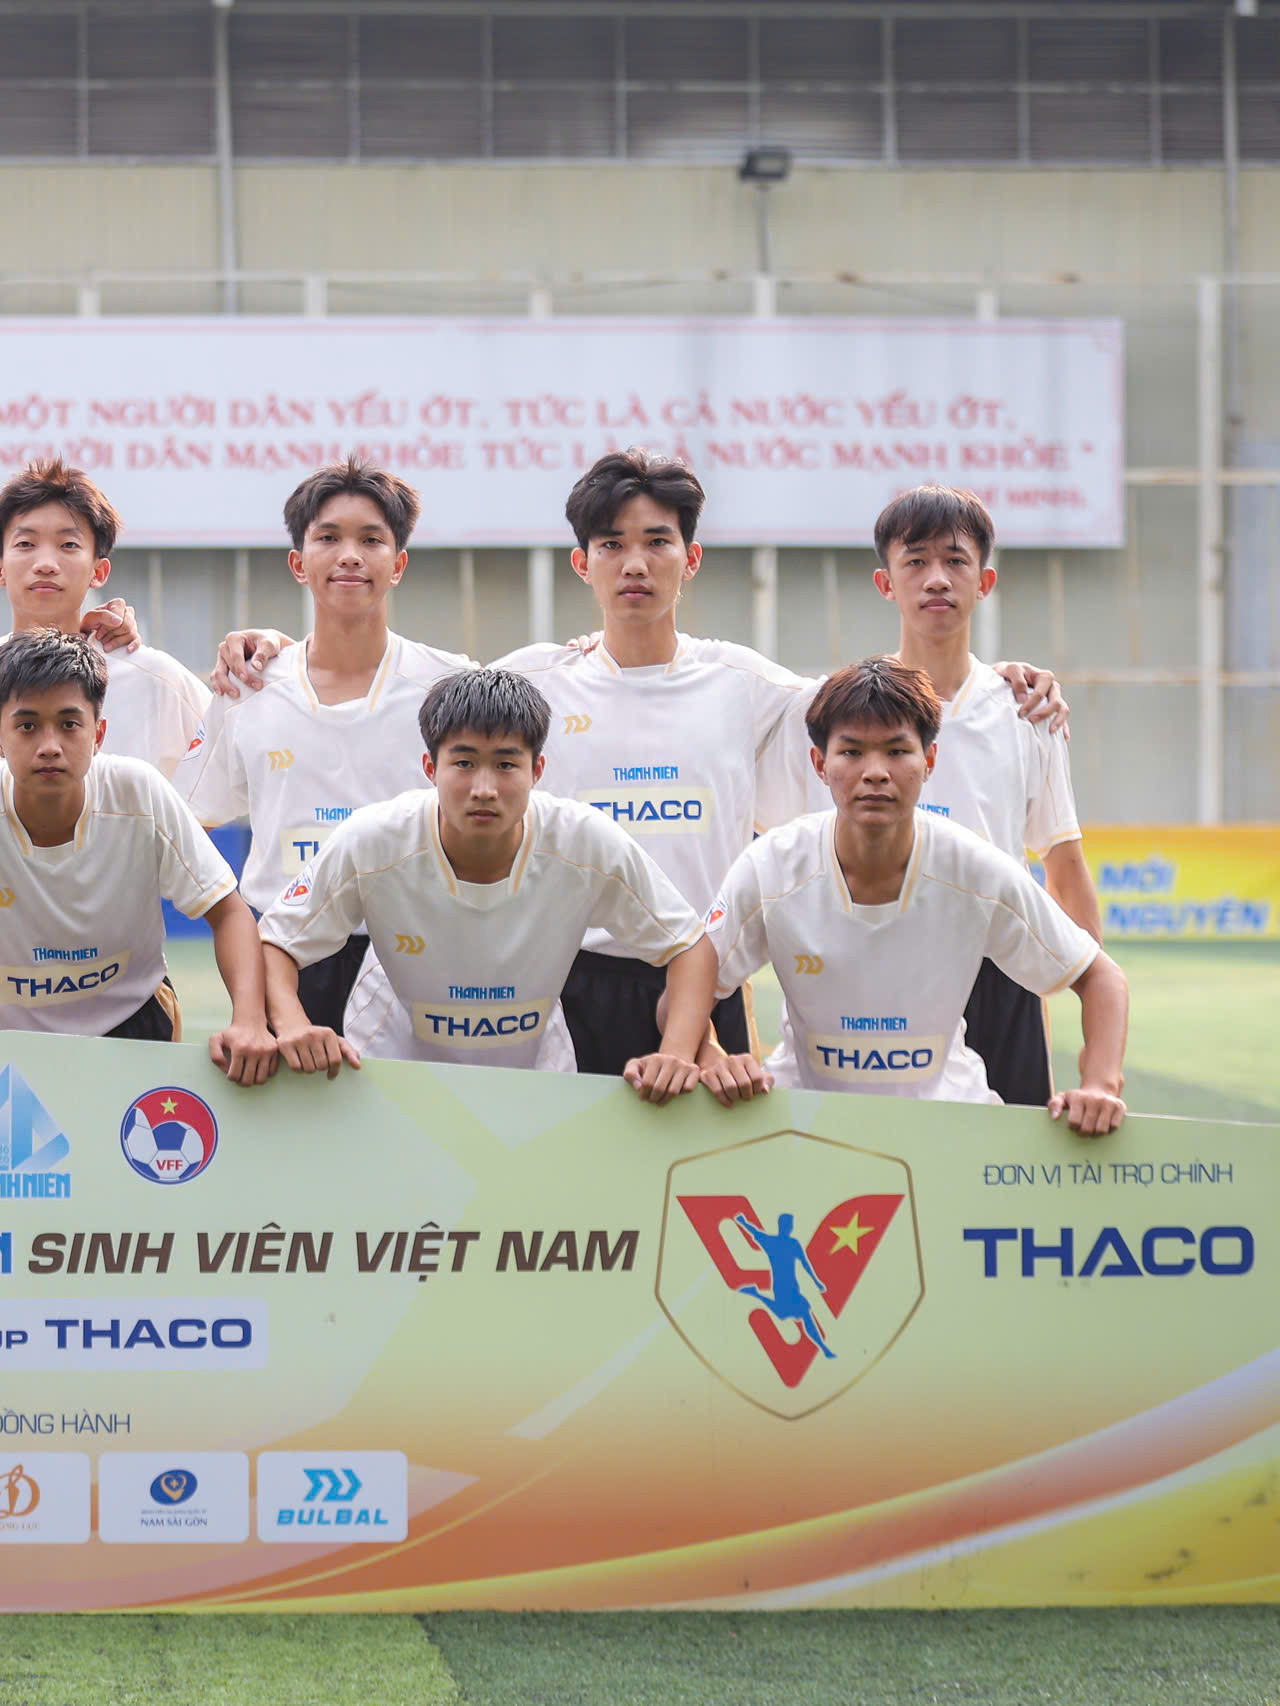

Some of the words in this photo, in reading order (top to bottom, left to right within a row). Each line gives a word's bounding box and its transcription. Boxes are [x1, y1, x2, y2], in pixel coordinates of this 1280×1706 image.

[614, 767, 652, 781] THANH
[32, 947, 71, 961] THANH
[7, 962, 119, 998] THACO
[448, 985, 488, 1000] THANH
[424, 1011, 540, 1037] THACO
[840, 1016, 880, 1031] THANH
[816, 1045, 934, 1071] THACO
[156, 1159, 184, 1172] VFF
[983, 1164, 1035, 1185] ĐƠN
[1041, 1164, 1061, 1188] VỊ
[1068, 1160, 1102, 1184] TÀI
[1109, 1163, 1154, 1187] TRỢ
[1161, 1158, 1233, 1184] CHÍNH
[28, 1232, 175, 1275] SINH
[196, 1222, 334, 1273] VIÊN
[355, 1221, 481, 1282] VIỆT
[495, 1230, 640, 1272] NAM
[963, 1226, 1255, 1278] THACO
[45, 1318, 253, 1349] THACO
[61, 1409, 131, 1435] HÀNH
[141, 1517, 164, 1527] NAM
[277, 1509, 389, 1525] BULBAL
